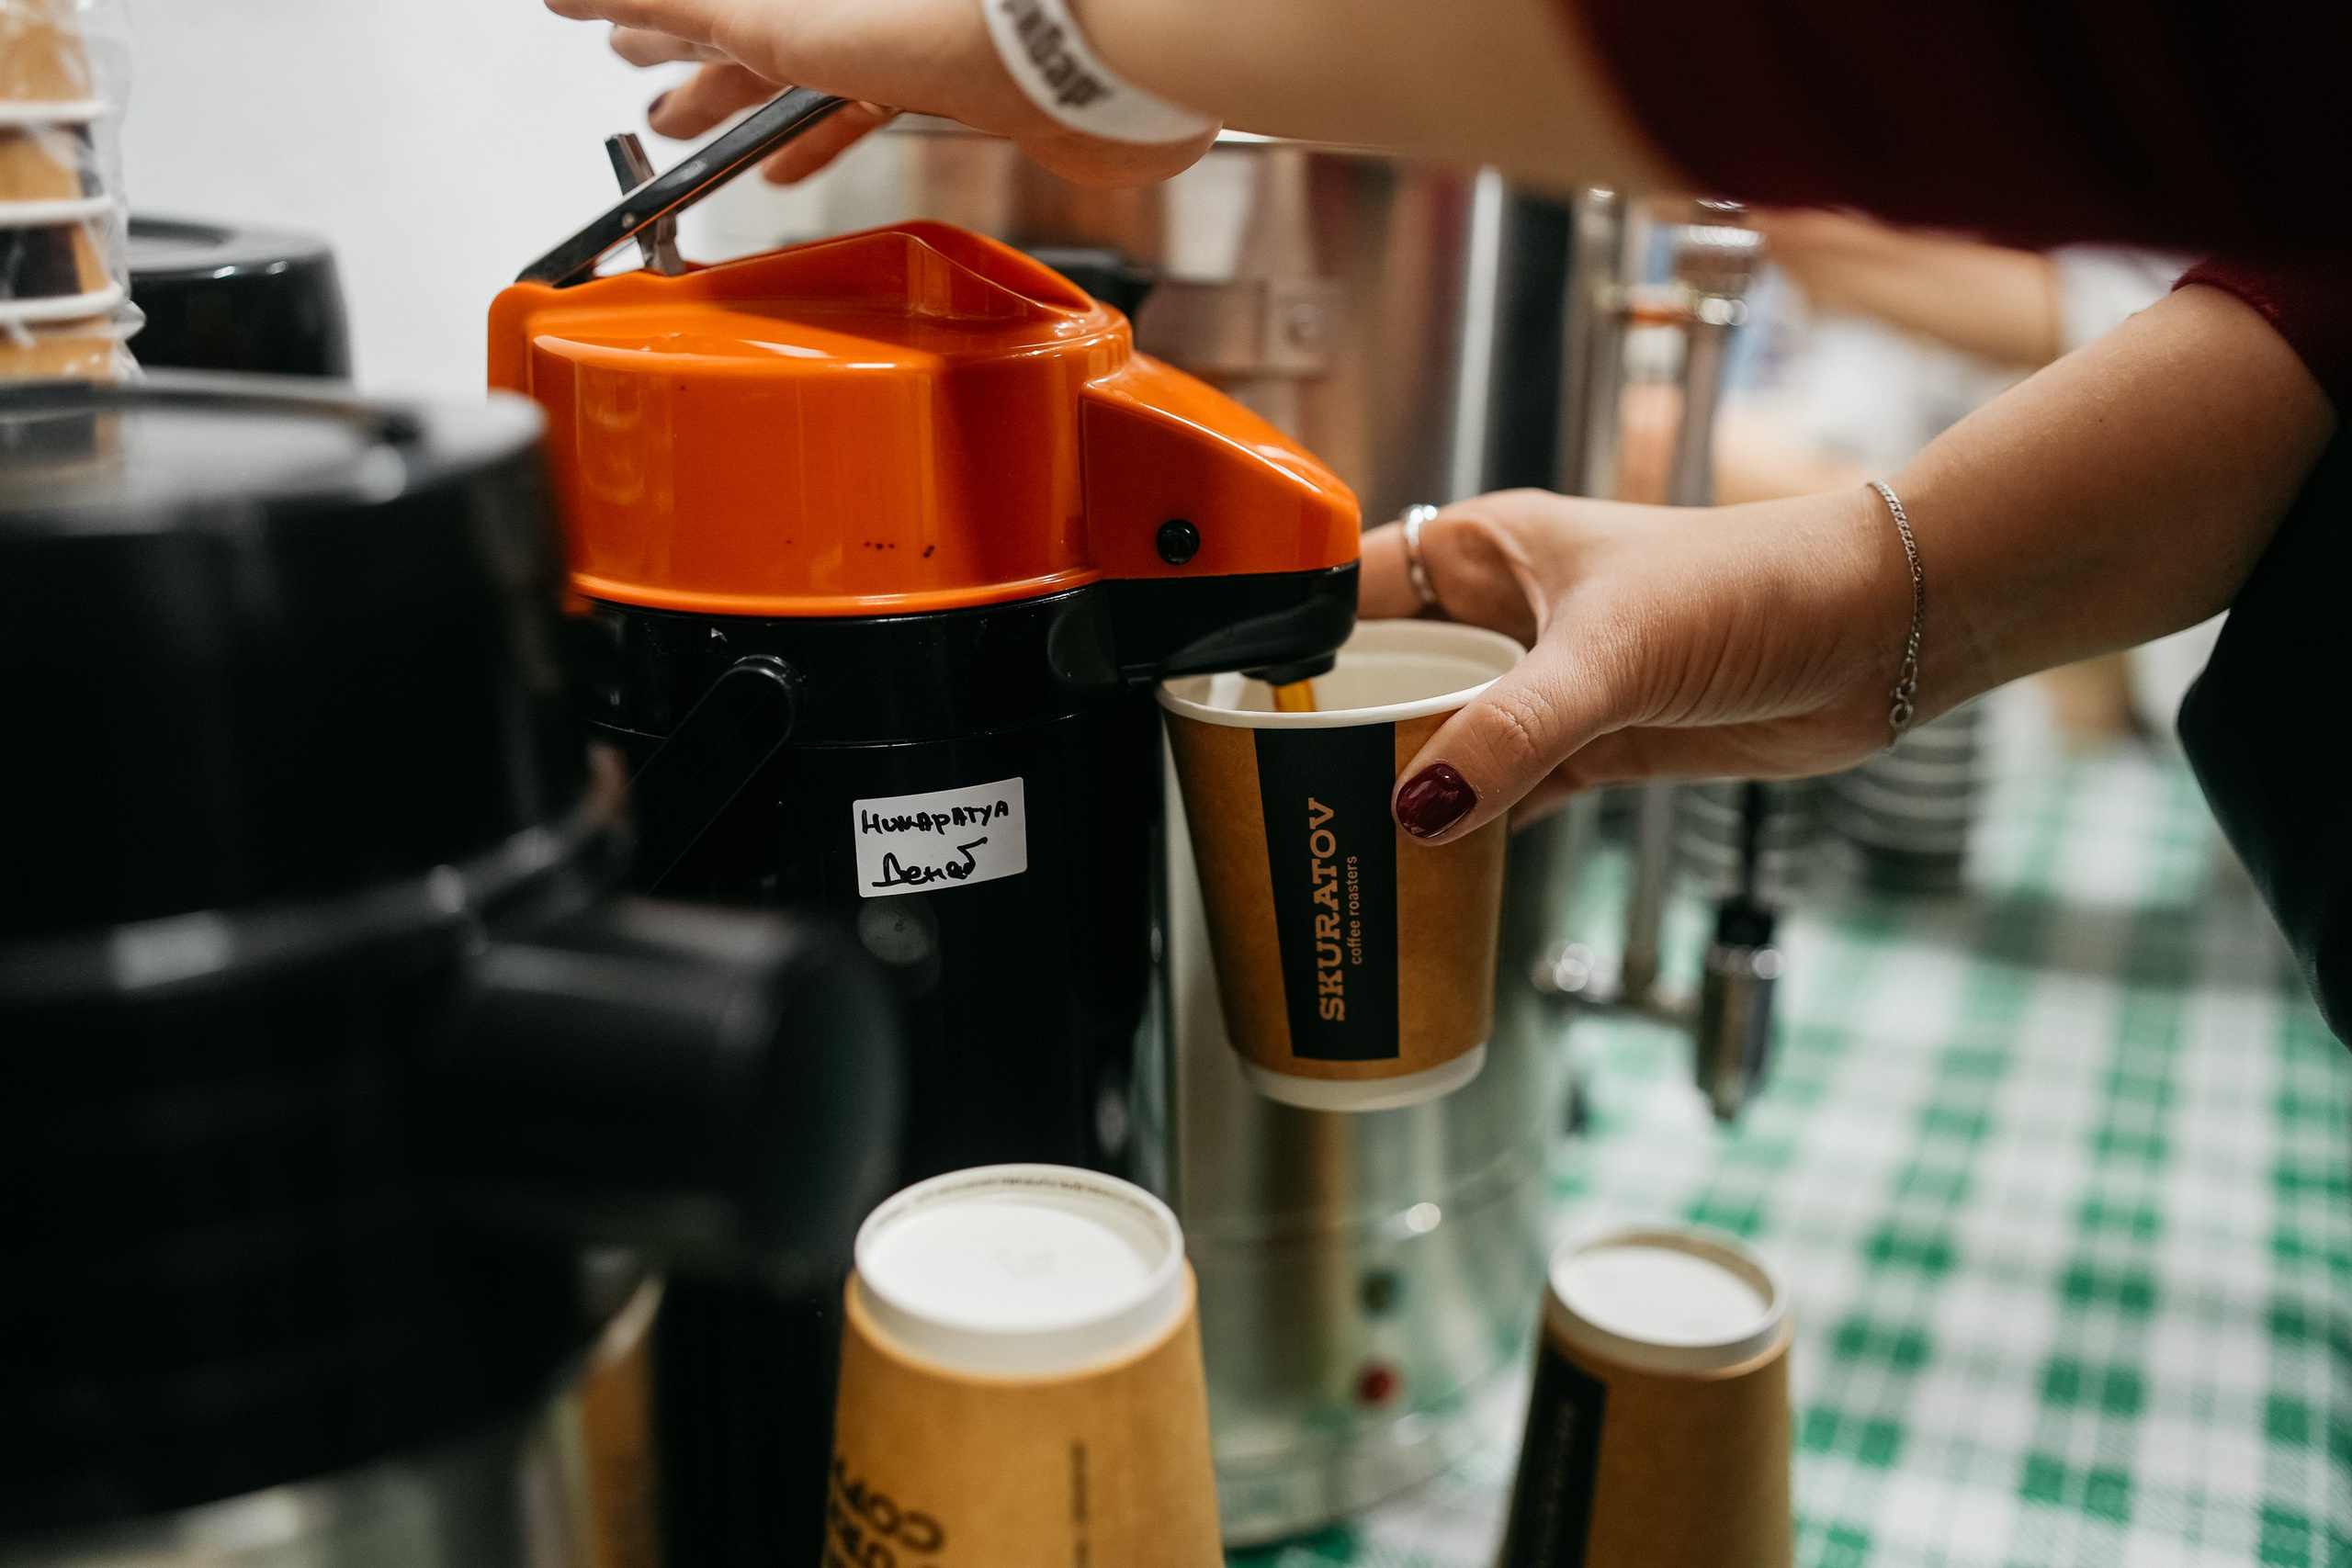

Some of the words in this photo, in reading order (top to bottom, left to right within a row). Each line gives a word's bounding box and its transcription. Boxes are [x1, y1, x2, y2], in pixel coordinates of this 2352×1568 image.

[1308, 797, 1345, 1021] SKURATOV
[1346, 856, 1359, 916] roasters
[1347, 920, 1363, 964] coffee
